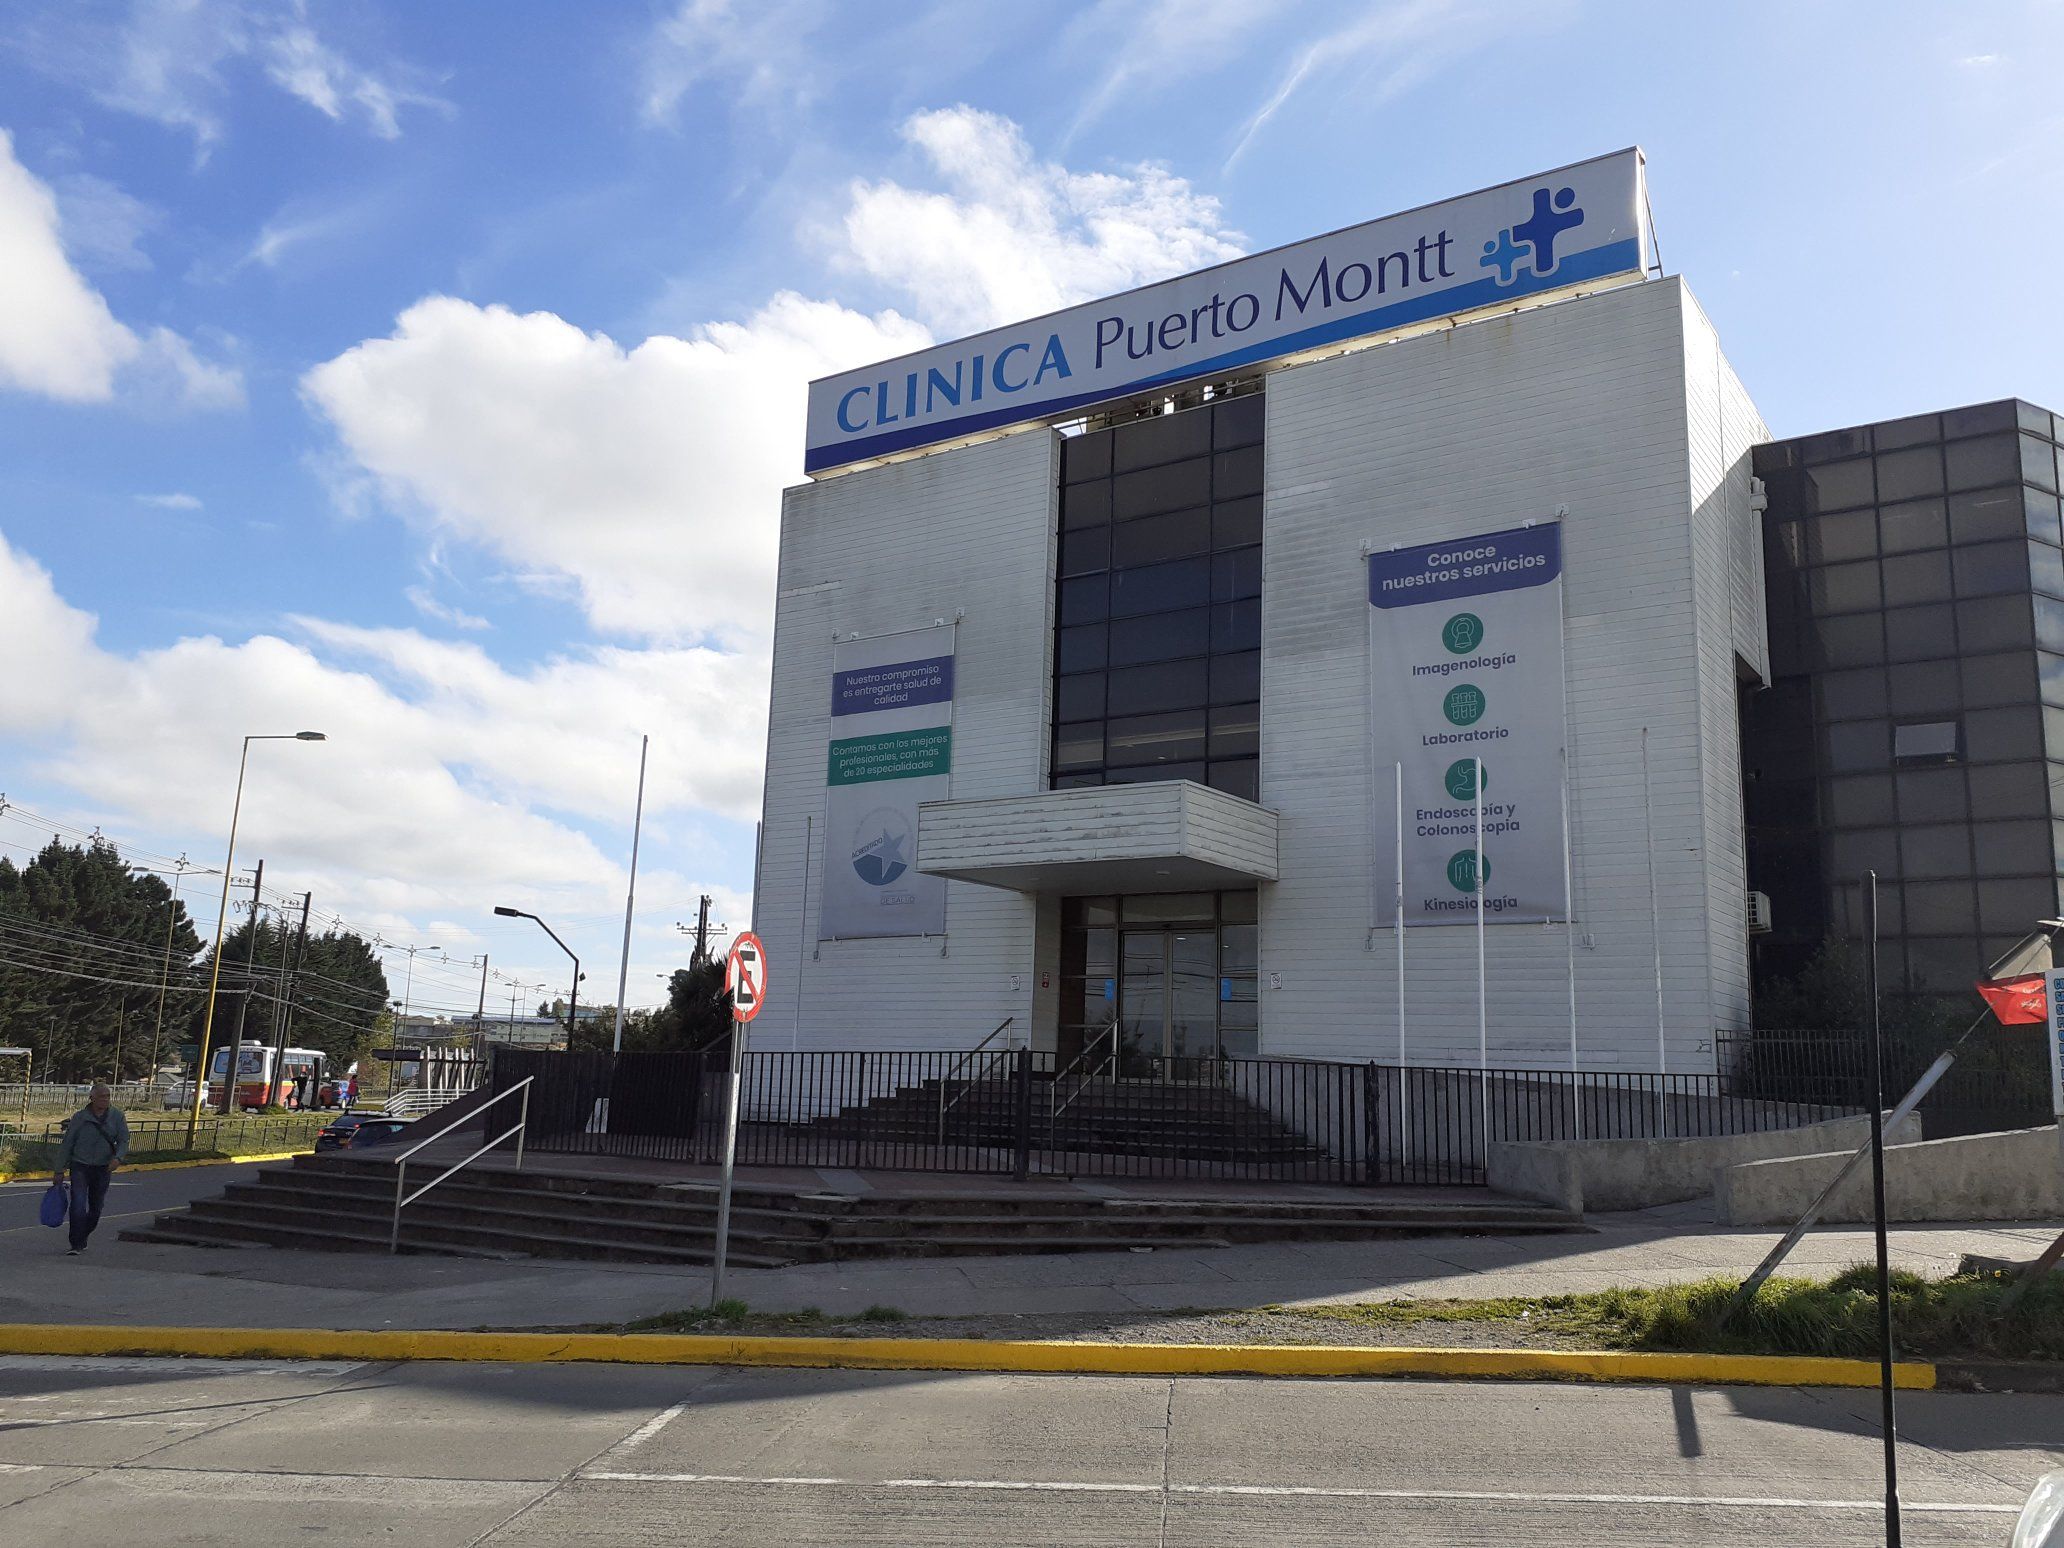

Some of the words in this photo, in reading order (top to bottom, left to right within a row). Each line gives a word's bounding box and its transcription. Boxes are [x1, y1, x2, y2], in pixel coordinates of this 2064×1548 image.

[836, 334, 1073, 433] CLINICA
[1095, 293, 1260, 369] Puerto
[1275, 230, 1455, 321] Montt
[1427, 546, 1497, 567] Conoce
[1382, 568, 1460, 591] nuestros
[1463, 553, 1546, 578] servicios
[1412, 652, 1516, 676] Imagenología
[846, 673, 880, 686] Nuestro
[881, 664, 940, 681] compromiso
[843, 689, 853, 698] es
[854, 682, 902, 696] entregarte
[903, 677, 928, 690] salud
[929, 675, 942, 687] de
[874, 692, 908, 705] calidad
[832, 743, 877, 756] Contamos
[878, 741, 895, 750] con
[896, 739, 909, 748] los
[911, 735, 948, 748] mejores
[1422, 727, 1509, 746] Laboratorio
[900, 750, 917, 759] con
[918, 747, 939, 757] más
[843, 768, 854, 778] de
[855, 767, 865, 776] 20
[867, 759, 934, 775] especialidades
[1506, 804, 1516, 818] y
[1424, 895, 1518, 912] Kinesioogía
[737, 950, 756, 1003] E
